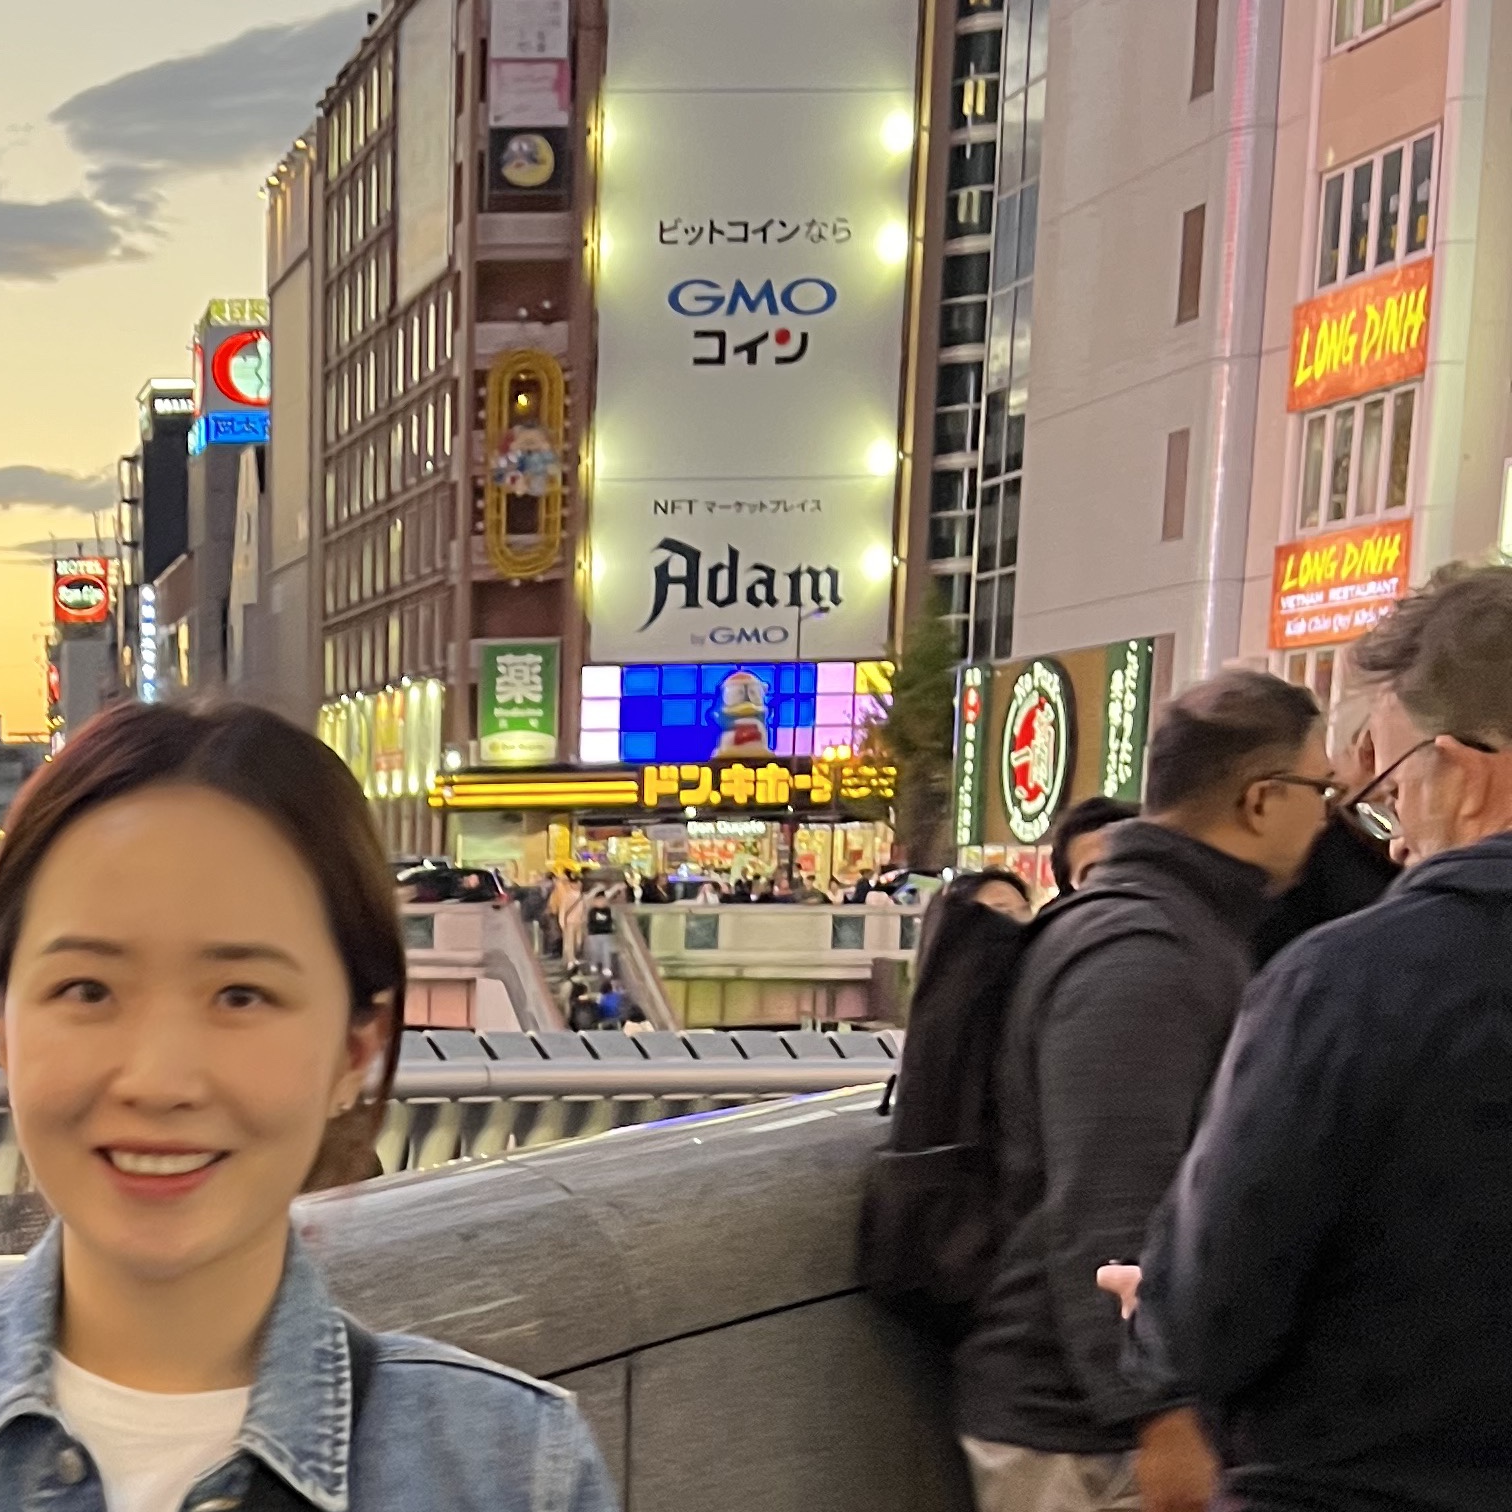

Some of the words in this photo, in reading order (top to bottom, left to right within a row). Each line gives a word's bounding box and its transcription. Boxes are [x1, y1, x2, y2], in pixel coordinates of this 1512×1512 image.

[658, 217, 853, 246] ビットコインなら
[667, 277, 838, 317] GMO
[692, 328, 810, 366] コイン
[1294, 310, 1358, 388] LONG
[1360, 284, 1428, 367] DINH
[653, 499, 696, 516] NFT
[705, 498, 823, 515] マーケットプレイス
[1281, 545, 1338, 591] LONG
[1341, 533, 1401, 580] DINH
[635, 536, 844, 633] Adam
[708, 625, 789, 646] GMO
[495, 653, 544, 704] 薬
